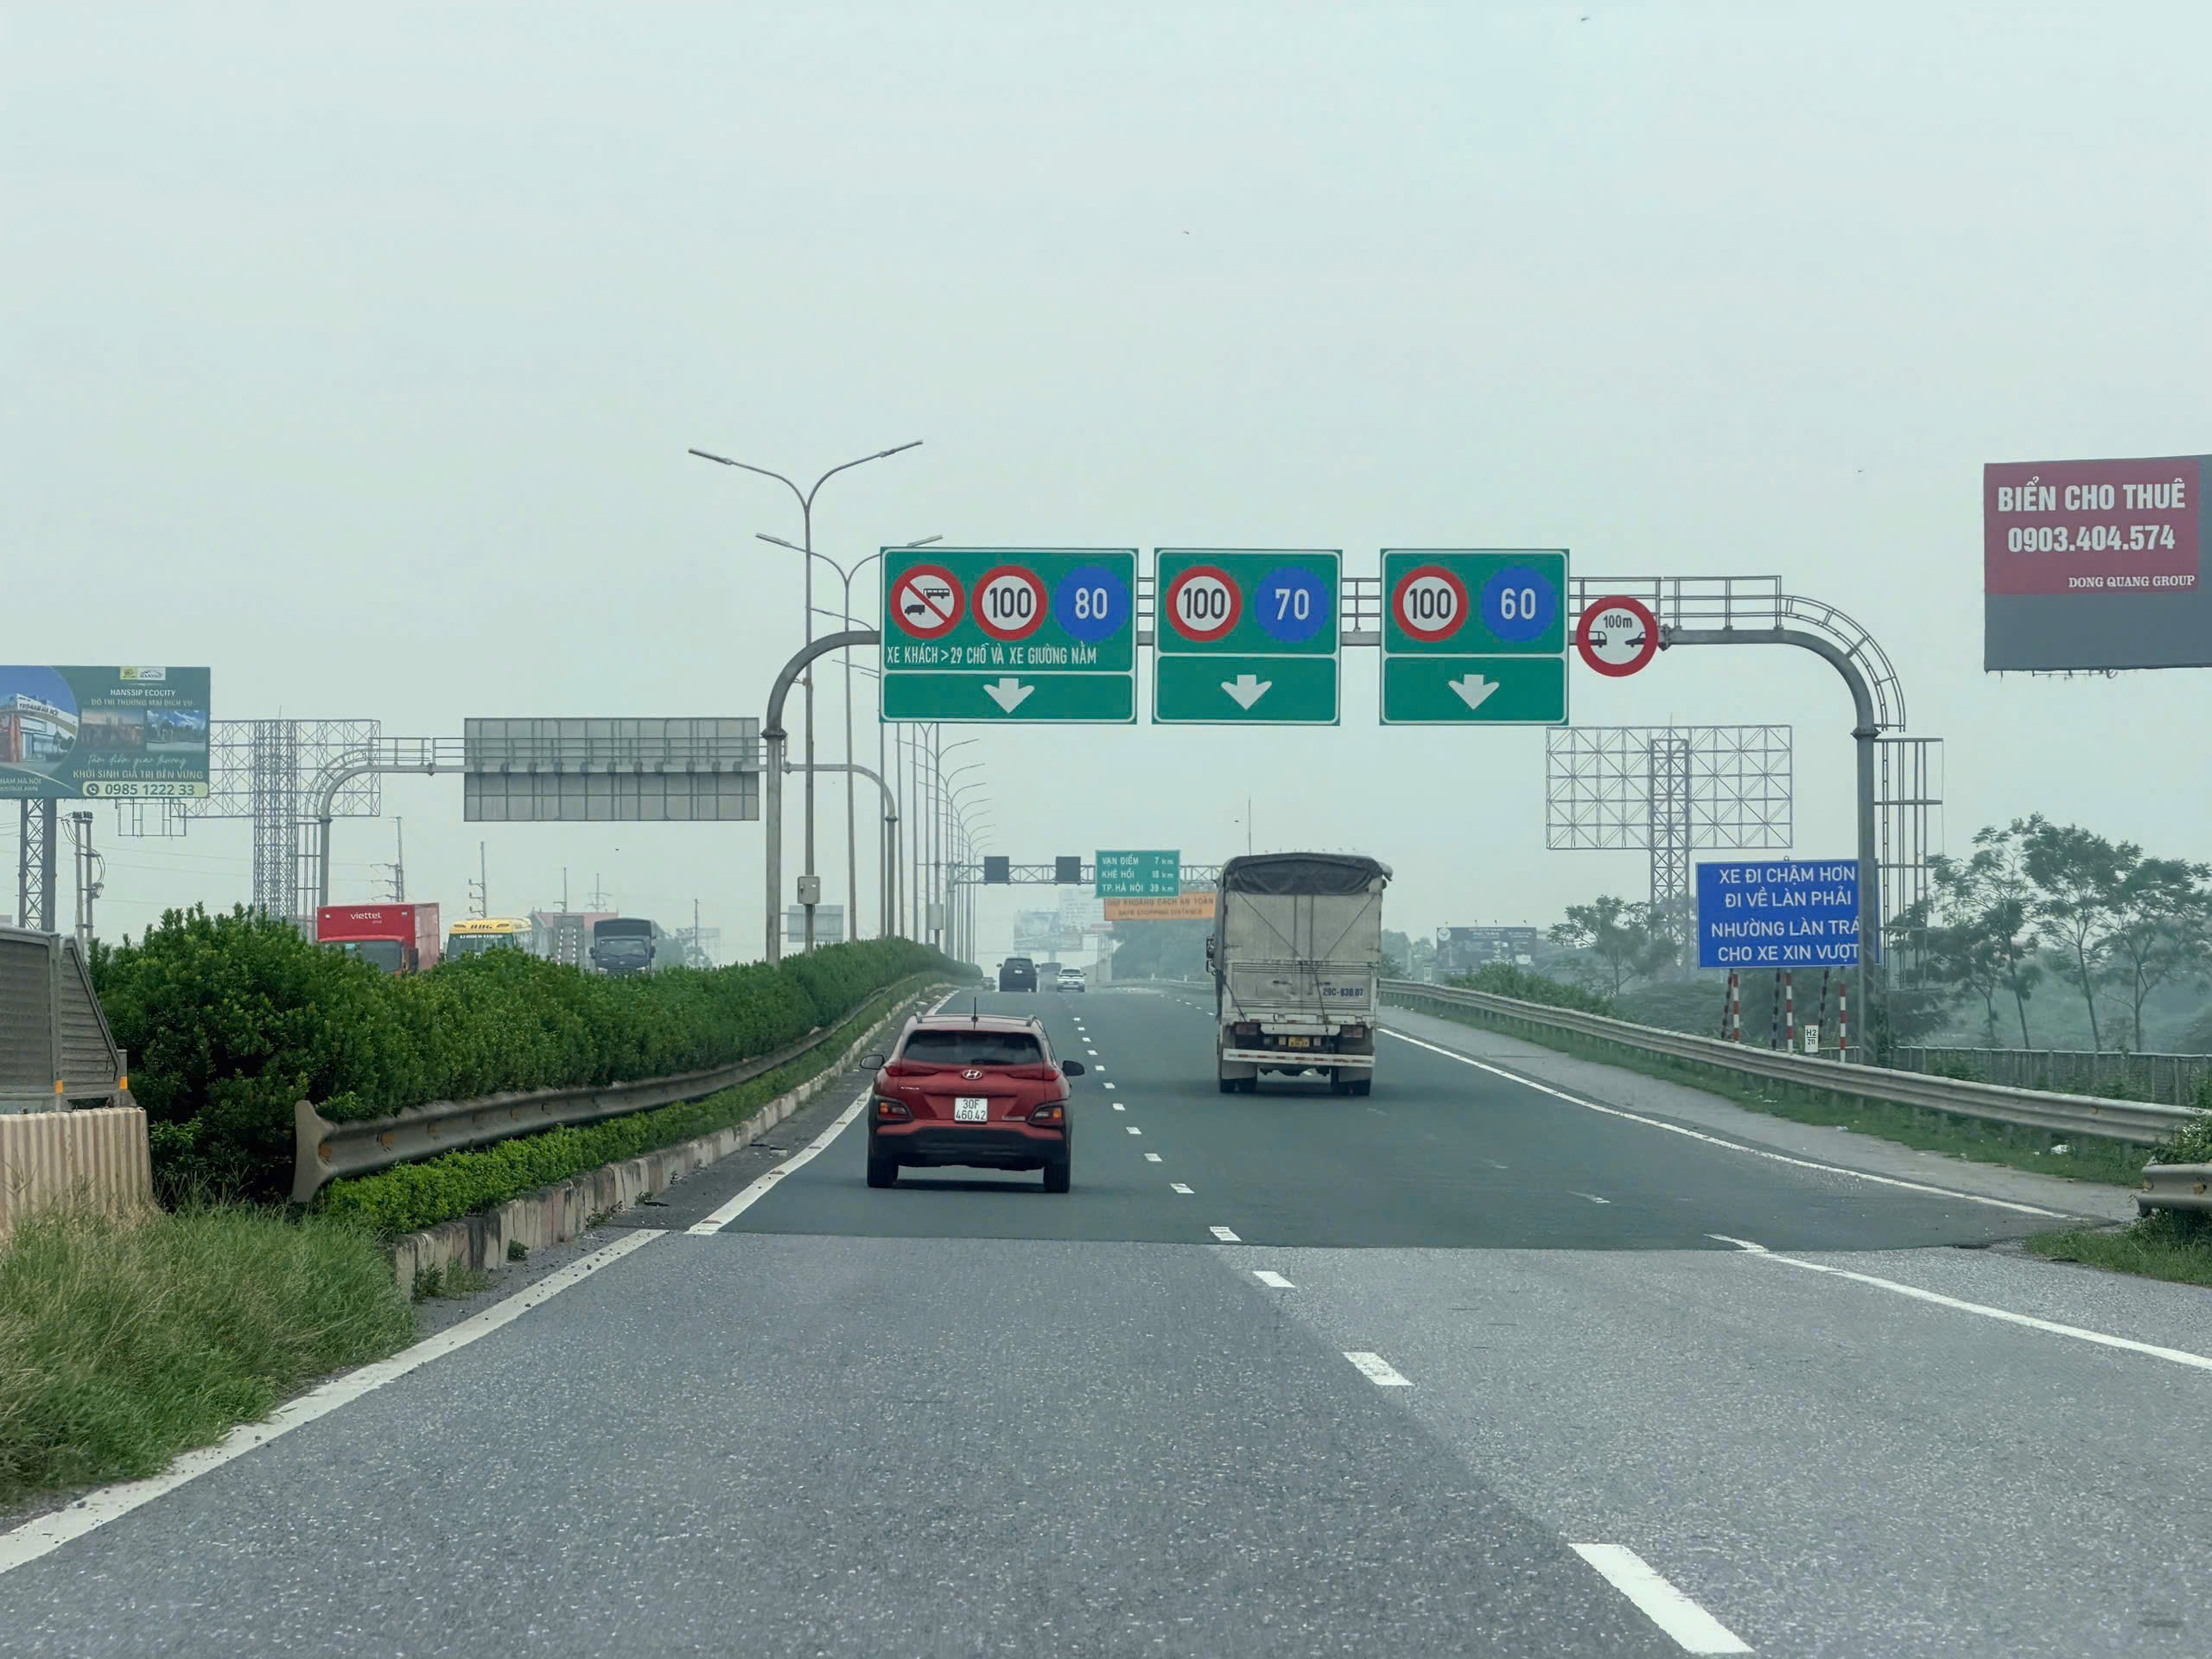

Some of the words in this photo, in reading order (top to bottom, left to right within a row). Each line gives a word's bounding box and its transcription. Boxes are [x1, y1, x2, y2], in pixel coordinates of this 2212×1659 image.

[1998, 476, 2056, 512] BIỂN
[2064, 484, 2114, 511] CHO
[2123, 478, 2185, 509] THUÊ
[2008, 524, 2175, 552] 0903.404.574
[2069, 576, 2103, 588] DONG
[2107, 576, 2149, 588] QUANG
[2152, 575, 2195, 586] GROUP
[989, 588, 1032, 618] 100
[1075, 588, 1108, 619] 80
[1183, 588, 1225, 620] 100
[1274, 588, 1310, 620] 70
[1408, 588, 1452, 620] 100
[1500, 588, 1536, 620] 60
[1603, 614, 1632, 629] 100m
[887, 647, 899, 664] XE
[991, 643, 1004, 664] VÀ
[1009, 647, 1023, 664] XE
[98, 770, 119, 779] SINH
[105, 784, 137, 795] 0985
[143, 785, 175, 795] 1222
[178, 785, 194, 795] 33
[1154, 856, 1160, 865] 7
[1161, 870, 1174, 879] km
[1719, 868, 1741, 884] XE
[1745, 868, 1761, 884] ĐI
[1766, 865, 1814, 885] CHẬM
[1820, 866, 1855, 881] HƠN
[1725, 893, 1741, 907] ĐI
[1745, 887, 1768, 907] VỀ
[1772, 888, 1806, 906] LÀN
[1811, 887, 1851, 906] PHẢI
[1712, 918, 1784, 938] NHƯỜNG
[1789, 917, 1823, 936] LÀN
[1718, 947, 1751, 962] CHO
[1758, 946, 1778, 960] XE
[1783, 945, 1811, 960] XIN
[1816, 943, 1859, 963] VƯỢT
[963, 1099, 980, 1109] 30F
[956, 1110, 986, 1120] 460.42
